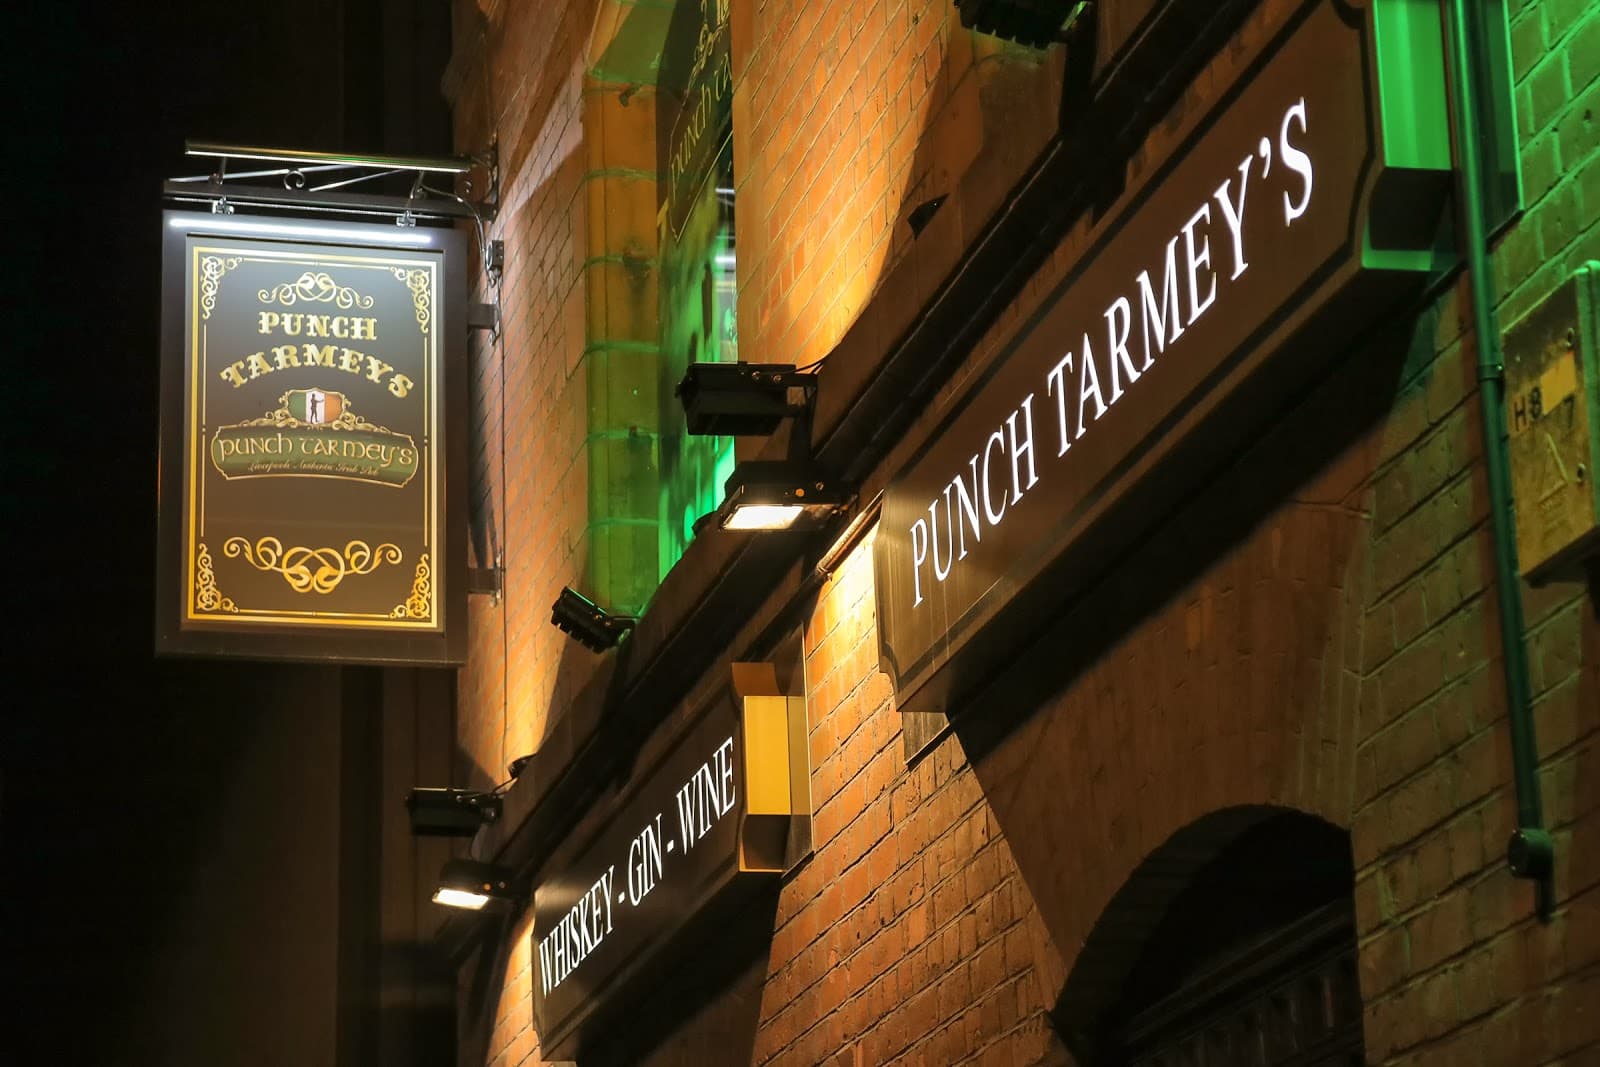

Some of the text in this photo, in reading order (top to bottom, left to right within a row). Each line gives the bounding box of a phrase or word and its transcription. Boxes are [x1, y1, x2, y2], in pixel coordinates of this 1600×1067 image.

[219, 343, 415, 399] TARMEYS
[258, 311, 378, 341] PUNCH
[910, 96, 1314, 608] PUNCH TARMEY'S
[538, 864, 615, 999] WHISKEY
[628, 812, 663, 907] GIN
[676, 735, 736, 856] WINE
